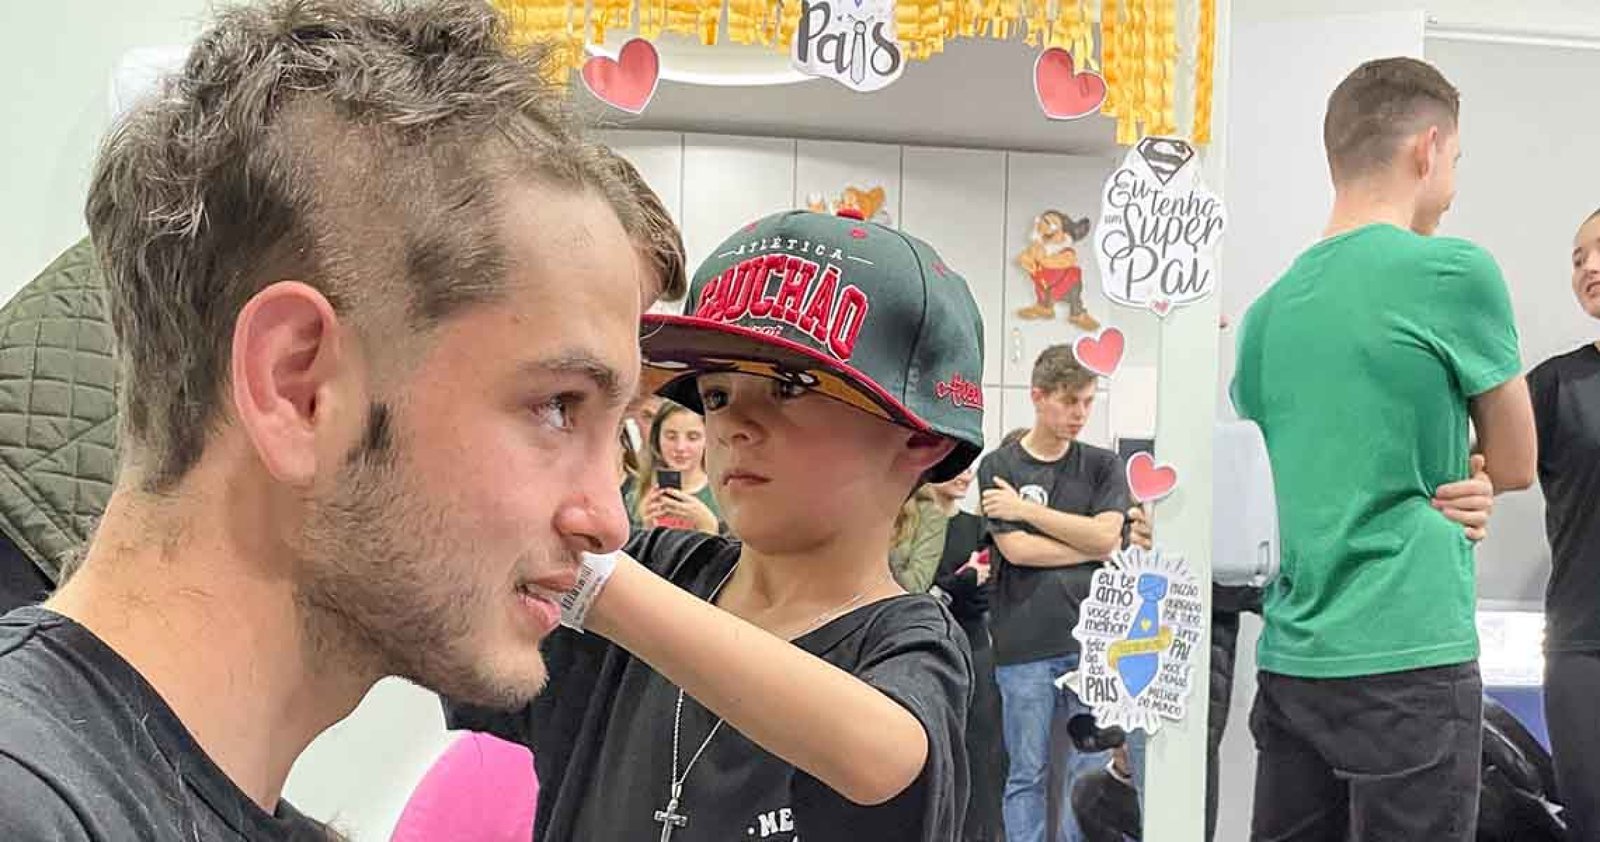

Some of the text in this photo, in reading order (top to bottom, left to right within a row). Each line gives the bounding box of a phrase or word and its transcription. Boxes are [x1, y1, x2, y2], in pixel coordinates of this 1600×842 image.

[1107, 168, 1151, 209] Eu
[1102, 203, 1223, 259] Super
[1110, 244, 1210, 300] Pai
[1098, 572, 1136, 589] eu te
[1095, 586, 1134, 607] amo
[1169, 638, 1192, 661] PAI
[1085, 675, 1119, 703] PAIS
